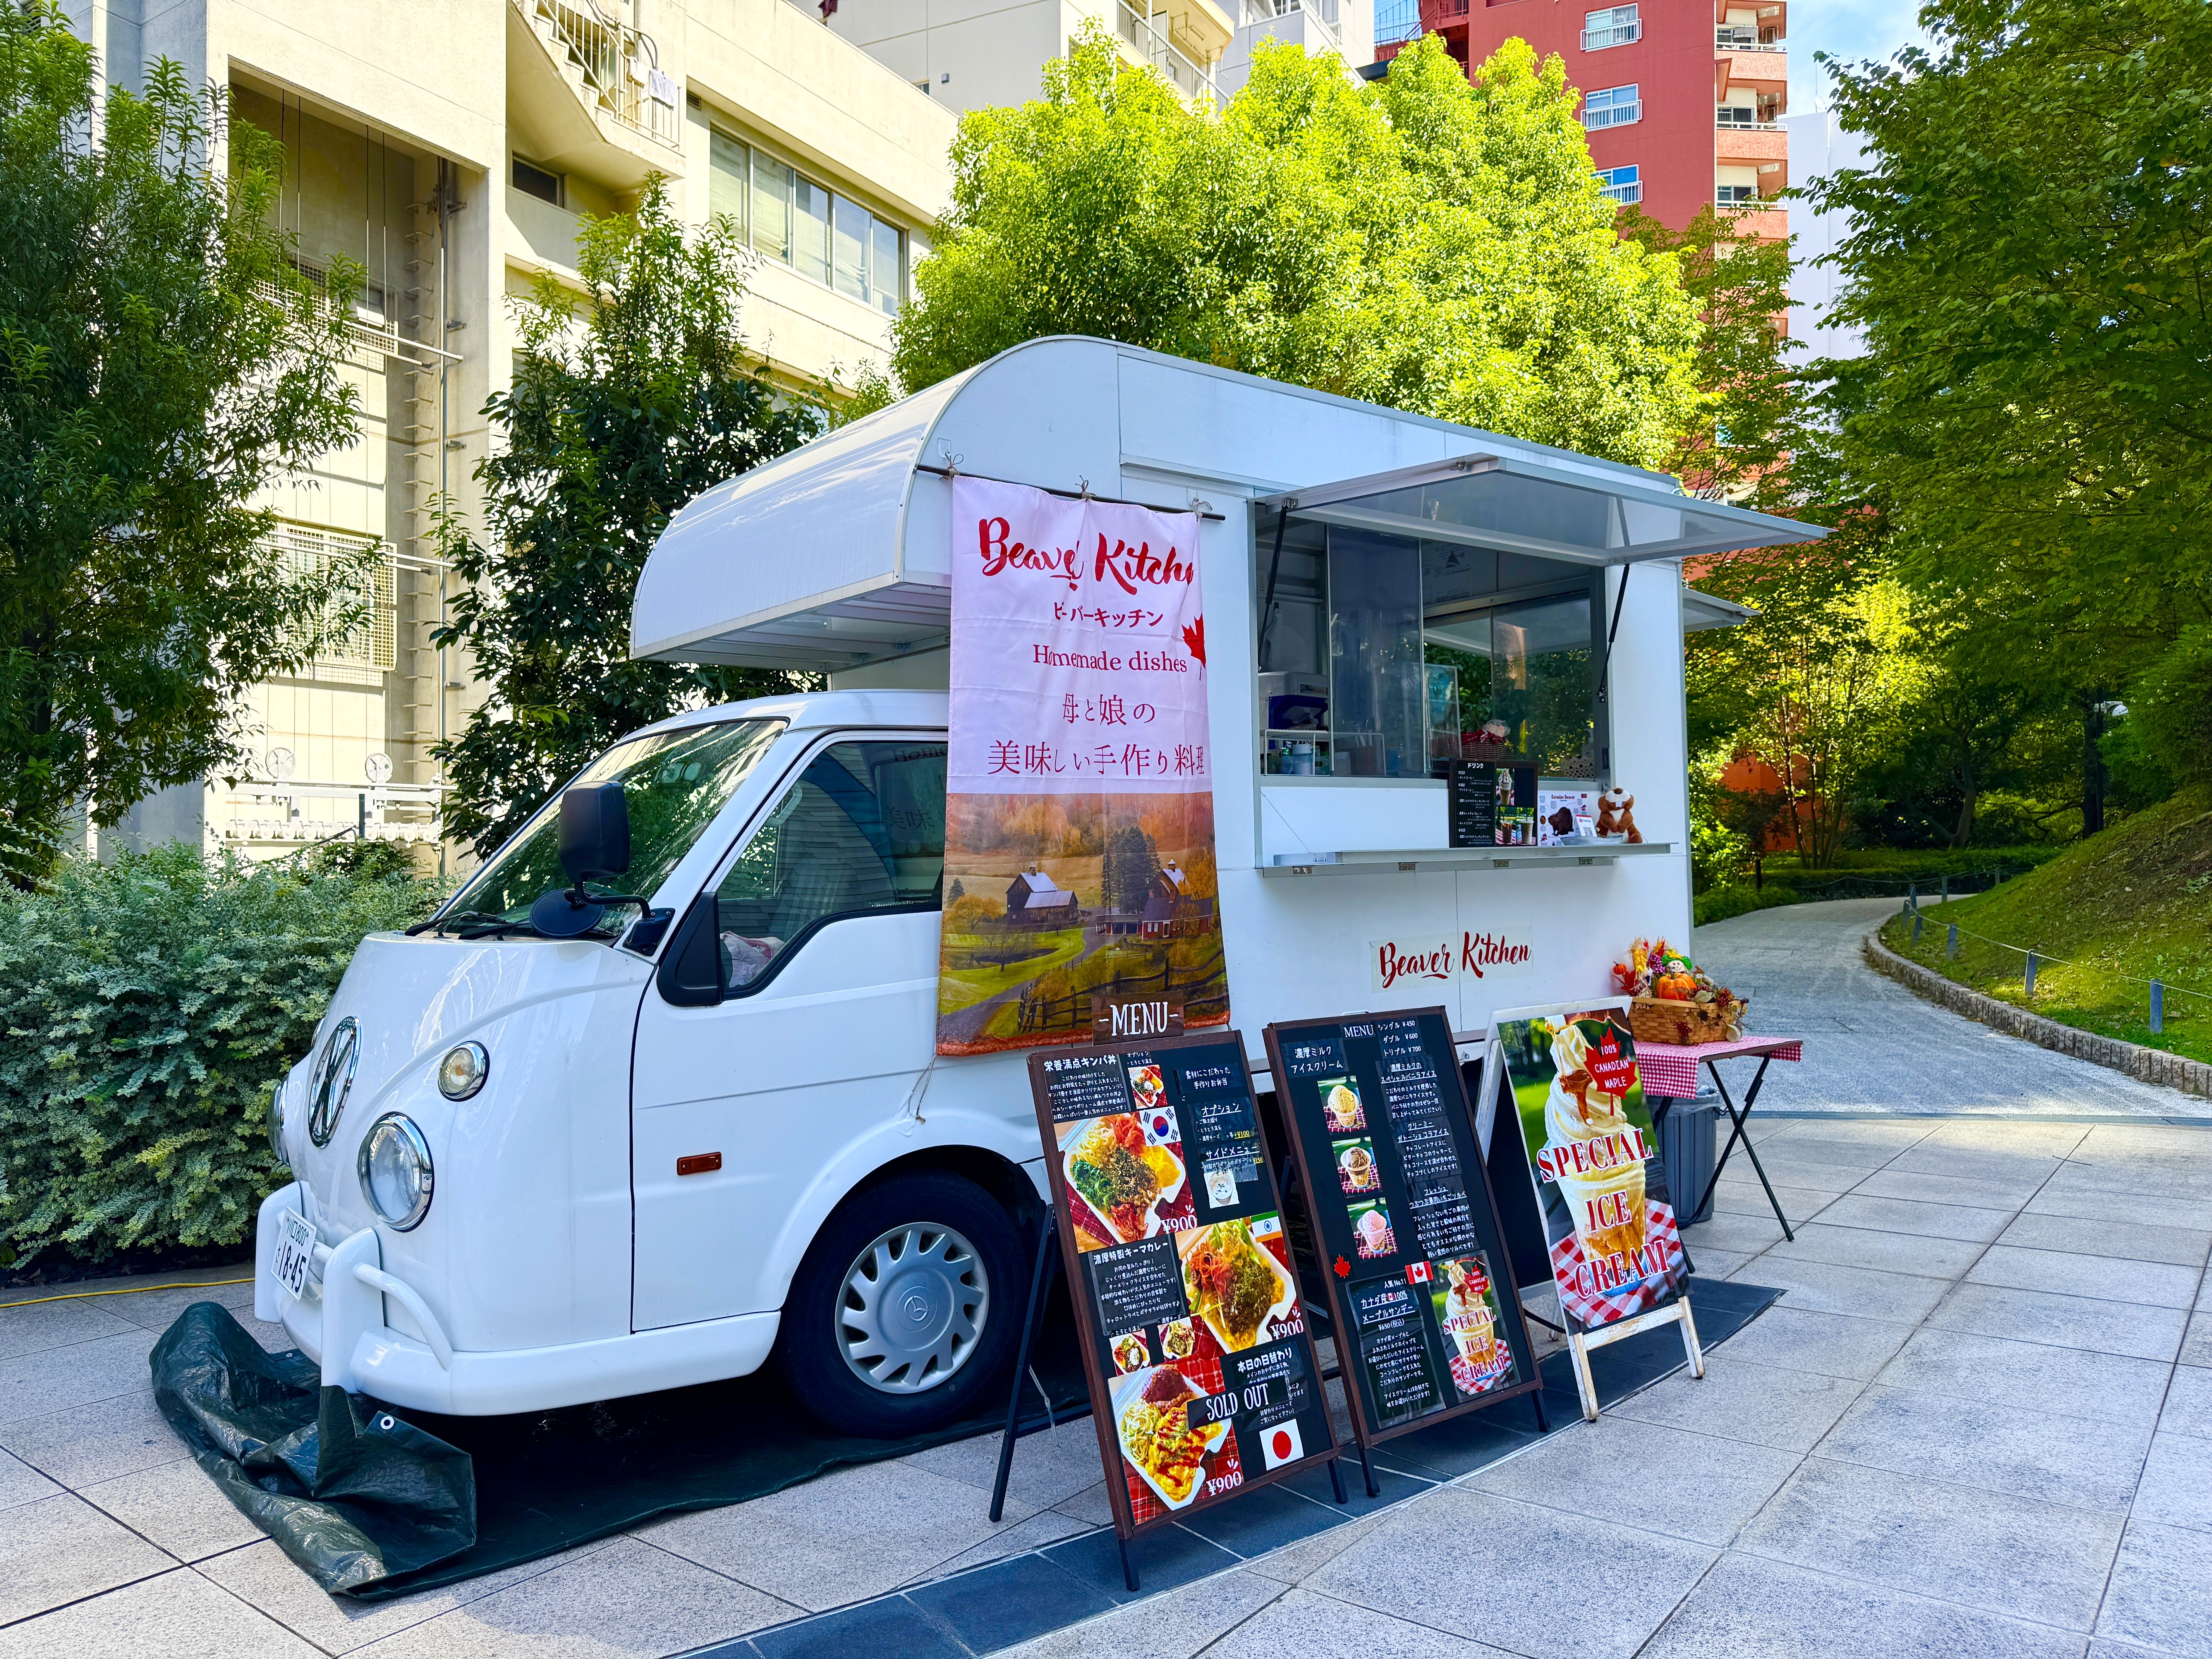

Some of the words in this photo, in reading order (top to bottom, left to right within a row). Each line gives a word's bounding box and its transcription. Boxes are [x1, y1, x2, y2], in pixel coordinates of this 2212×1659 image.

[1054, 601, 1163, 628] ビーバーキッチン
[1033, 644, 1121, 670] Homemade
[1128, 651, 1187, 672] dishes
[988, 740, 1204, 776] 美味しい手作り料理
[1379, 942, 1455, 988] Beaver
[1462, 931, 1532, 979] Kitchen
[1343, 1025, 1374, 1038] MENU
[1378, 1023, 1400, 1031] シングル
[1383, 1035, 1400, 1044] ダブル
[1295, 1046, 1331, 1058] 濃厚ミルク
[1384, 1048, 1405, 1056] トリプル
[1601, 1044, 1617, 1056] 100%
[1044, 1054, 1117, 1072] 栄養満点キンパ丼
[1291, 1060, 1343, 1073] アイスクリーム
[1390, 1062, 1421, 1072] 濃厚ミルクの
[1594, 1058, 1629, 1074] CANADIAN
[1185, 1067, 1230, 1080] 素材にこだわった
[1604, 1076, 1627, 1089] MAPLE
[1194, 1077, 1228, 1089] 手作りお弁当
[1201, 1103, 1239, 1115] オプション
[1408, 1121, 1432, 1130] クリーミー
[1206, 1146, 1257, 1159] サイドメニュー
[1536, 1127, 1654, 1184] SPECIAL
[1424, 1186, 1446, 1194] フレッシュ
[1584, 1190, 1632, 1234] ICE
[1161, 1215, 1197, 1234] ¥900
[1094, 1242, 1168, 1265] 濃厚特製キーマカレー
[1575, 1239, 1671, 1299] CREAM
[1394, 1290, 1407, 1300] 100%
[1363, 1304, 1413, 1322] メープルサンデー
[1442, 1307, 1497, 1335] SPECIAL
[1270, 1319, 1304, 1339] ¥900
[1465, 1335, 1489, 1355] ICE
[1238, 1347, 1292, 1373] 本日の日替わり
[1461, 1355, 1506, 1382] CREAM
[1206, 1392, 1238, 1421] SOLD
[1244, 1383, 1269, 1410] OUT
[1206, 1472, 1242, 1497] ¥900
